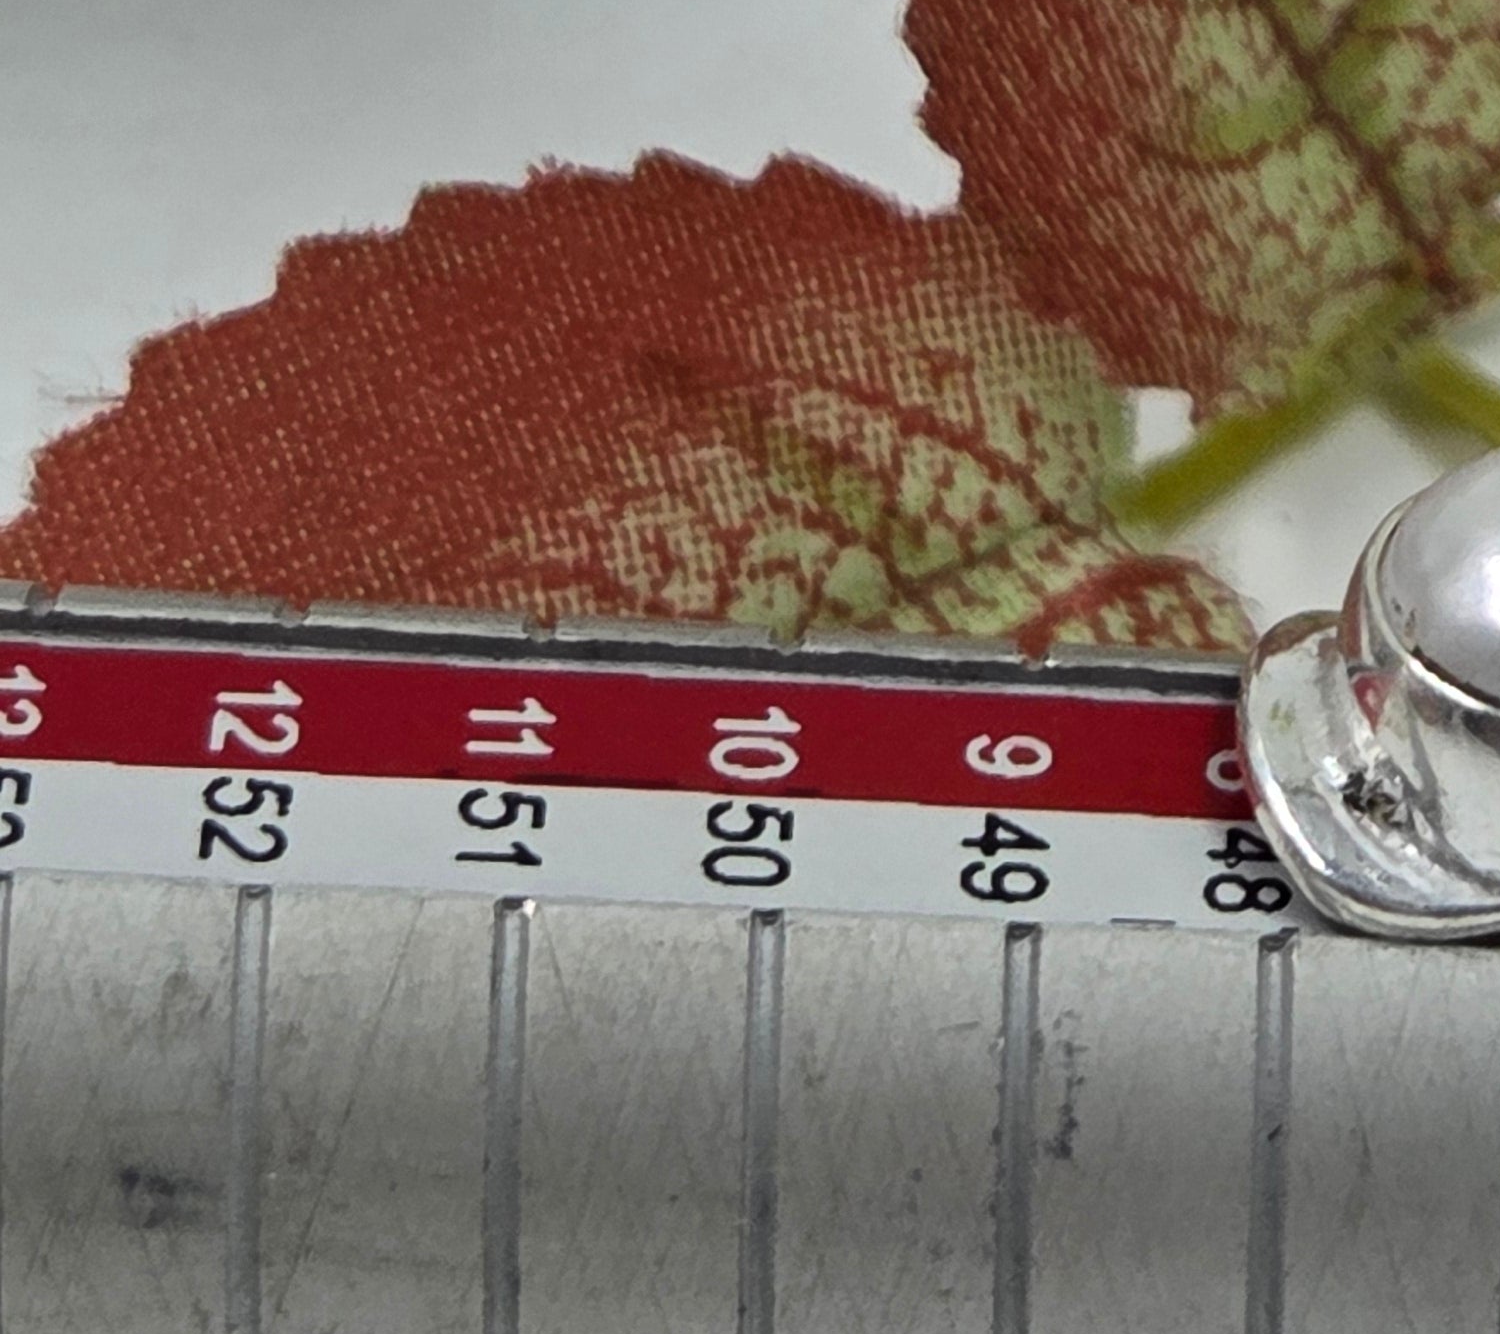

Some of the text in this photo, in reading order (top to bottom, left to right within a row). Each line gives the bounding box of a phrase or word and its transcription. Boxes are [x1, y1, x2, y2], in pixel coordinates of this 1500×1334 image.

[199, 679, 303, 863] 12 52
[454, 697, 557, 867] 11 51
[700, 706, 801, 887] 10 50
[960, 734, 1053, 904] 9 49
[1203, 827, 1293, 913] 48
